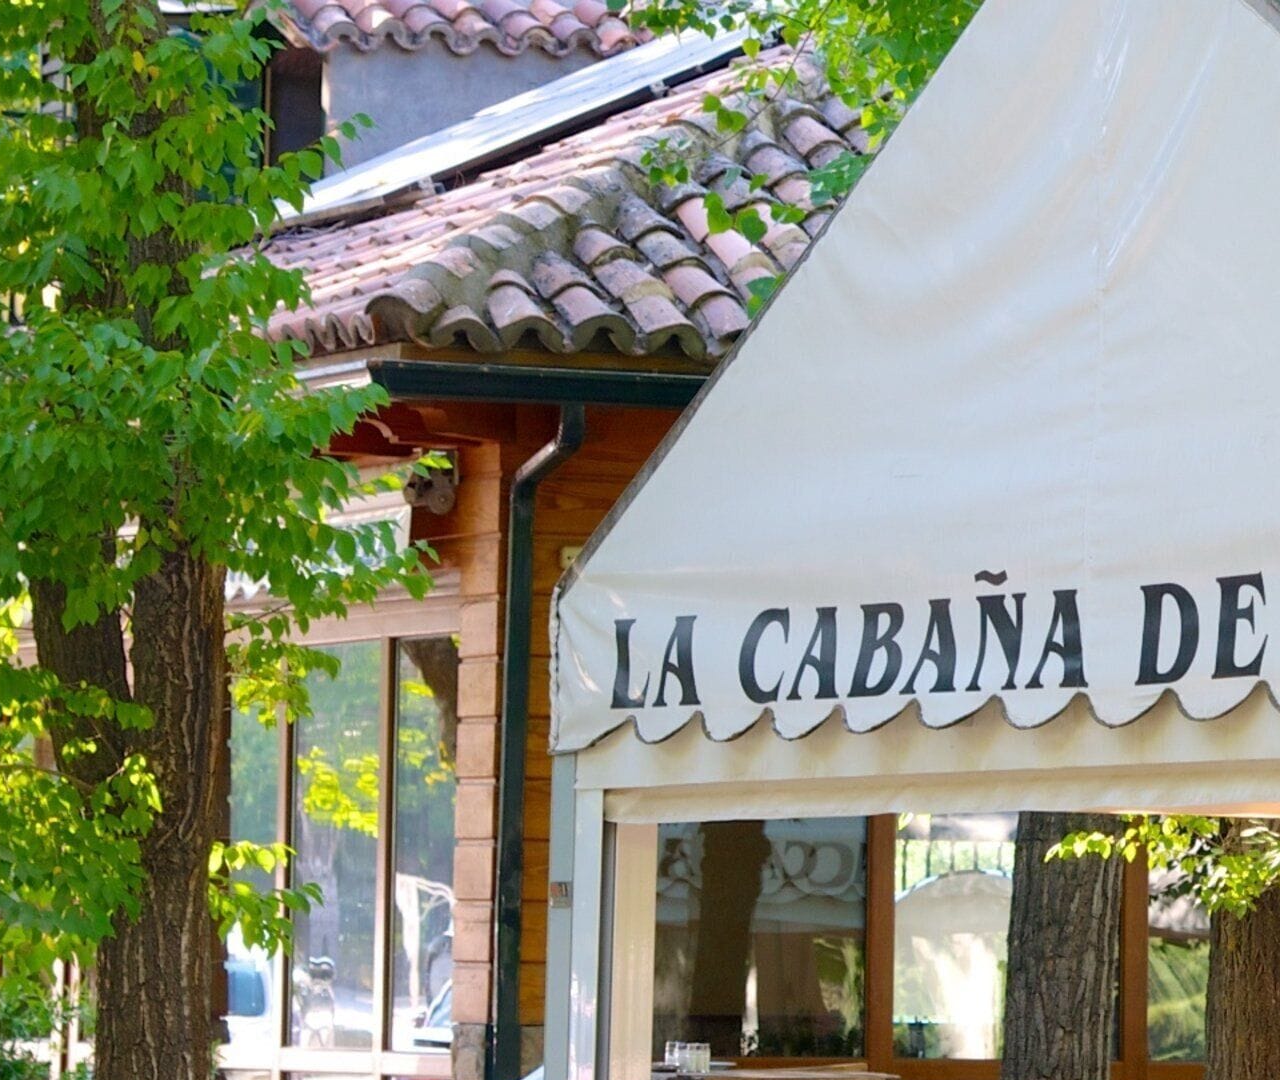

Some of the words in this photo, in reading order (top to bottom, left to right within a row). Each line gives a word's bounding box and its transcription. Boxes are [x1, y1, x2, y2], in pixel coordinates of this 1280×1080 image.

[609, 614, 702, 709] LA
[737, 570, 1089, 704] CABAÑA
[1134, 571, 1268, 687] DE
